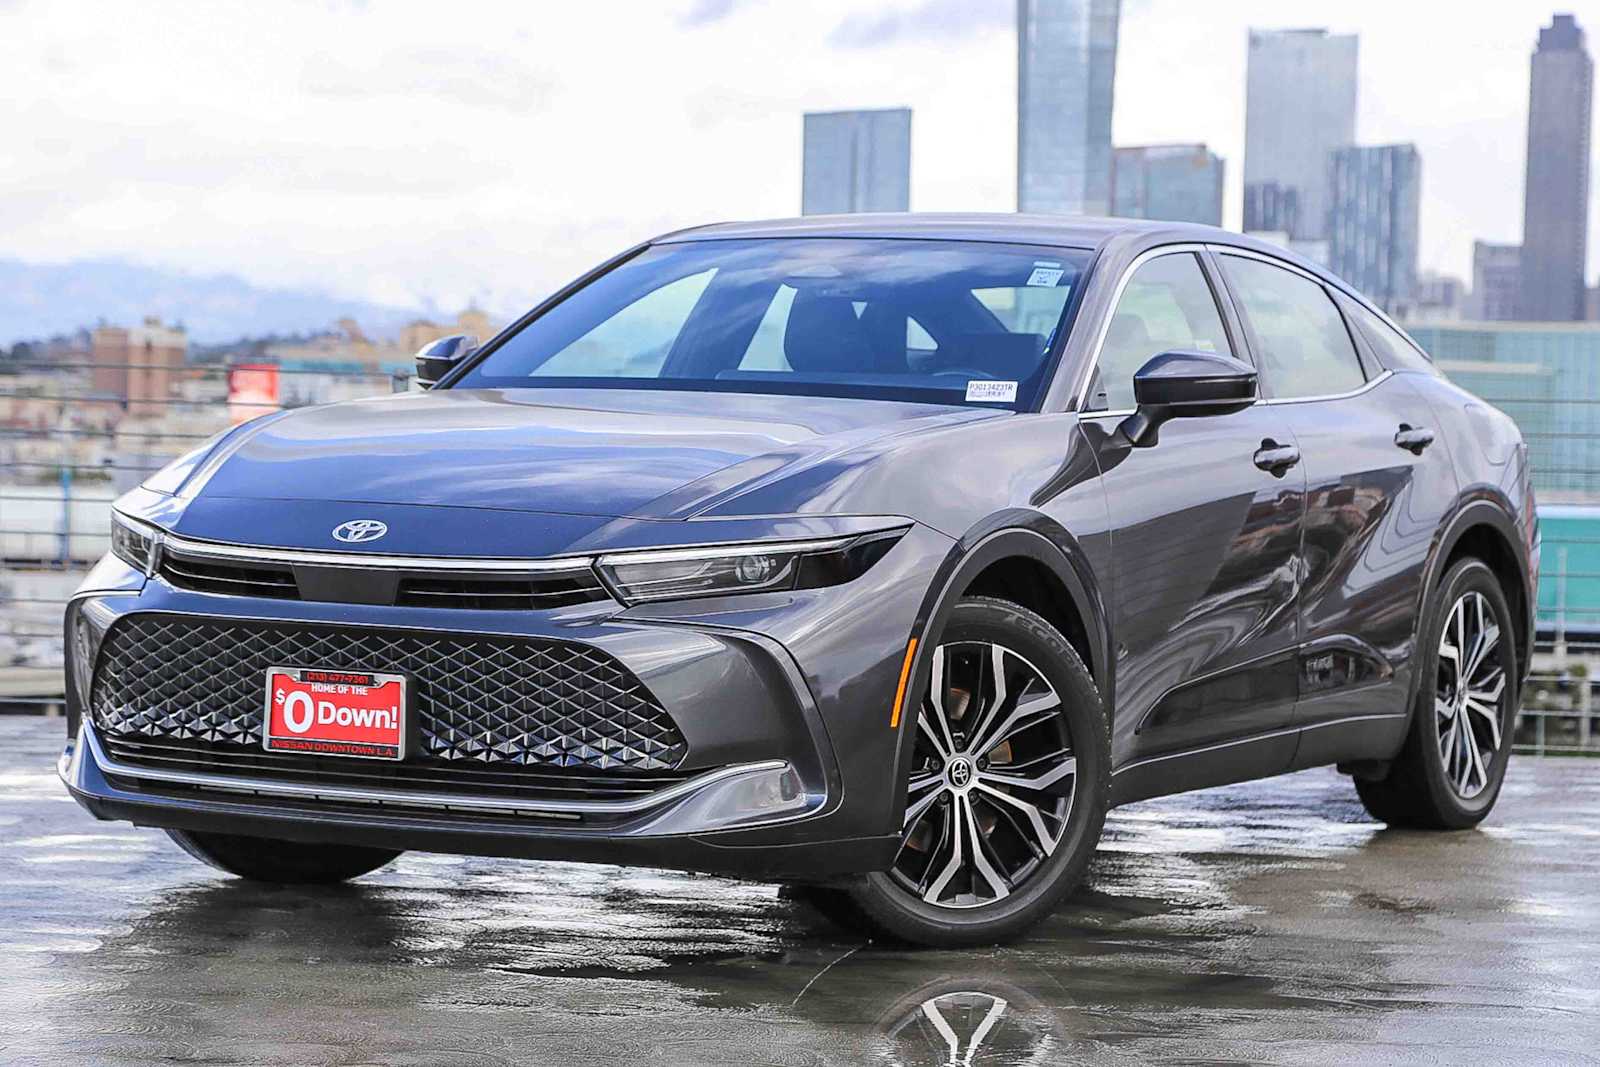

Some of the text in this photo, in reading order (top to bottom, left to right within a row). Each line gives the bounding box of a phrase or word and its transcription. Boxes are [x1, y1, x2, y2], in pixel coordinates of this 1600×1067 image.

[311, 683, 368, 696] HOME OF THE
[317, 701, 398, 729] Down!
[271, 740, 313, 751] NISSAN
[314, 741, 374, 754] DOWNTOWN
